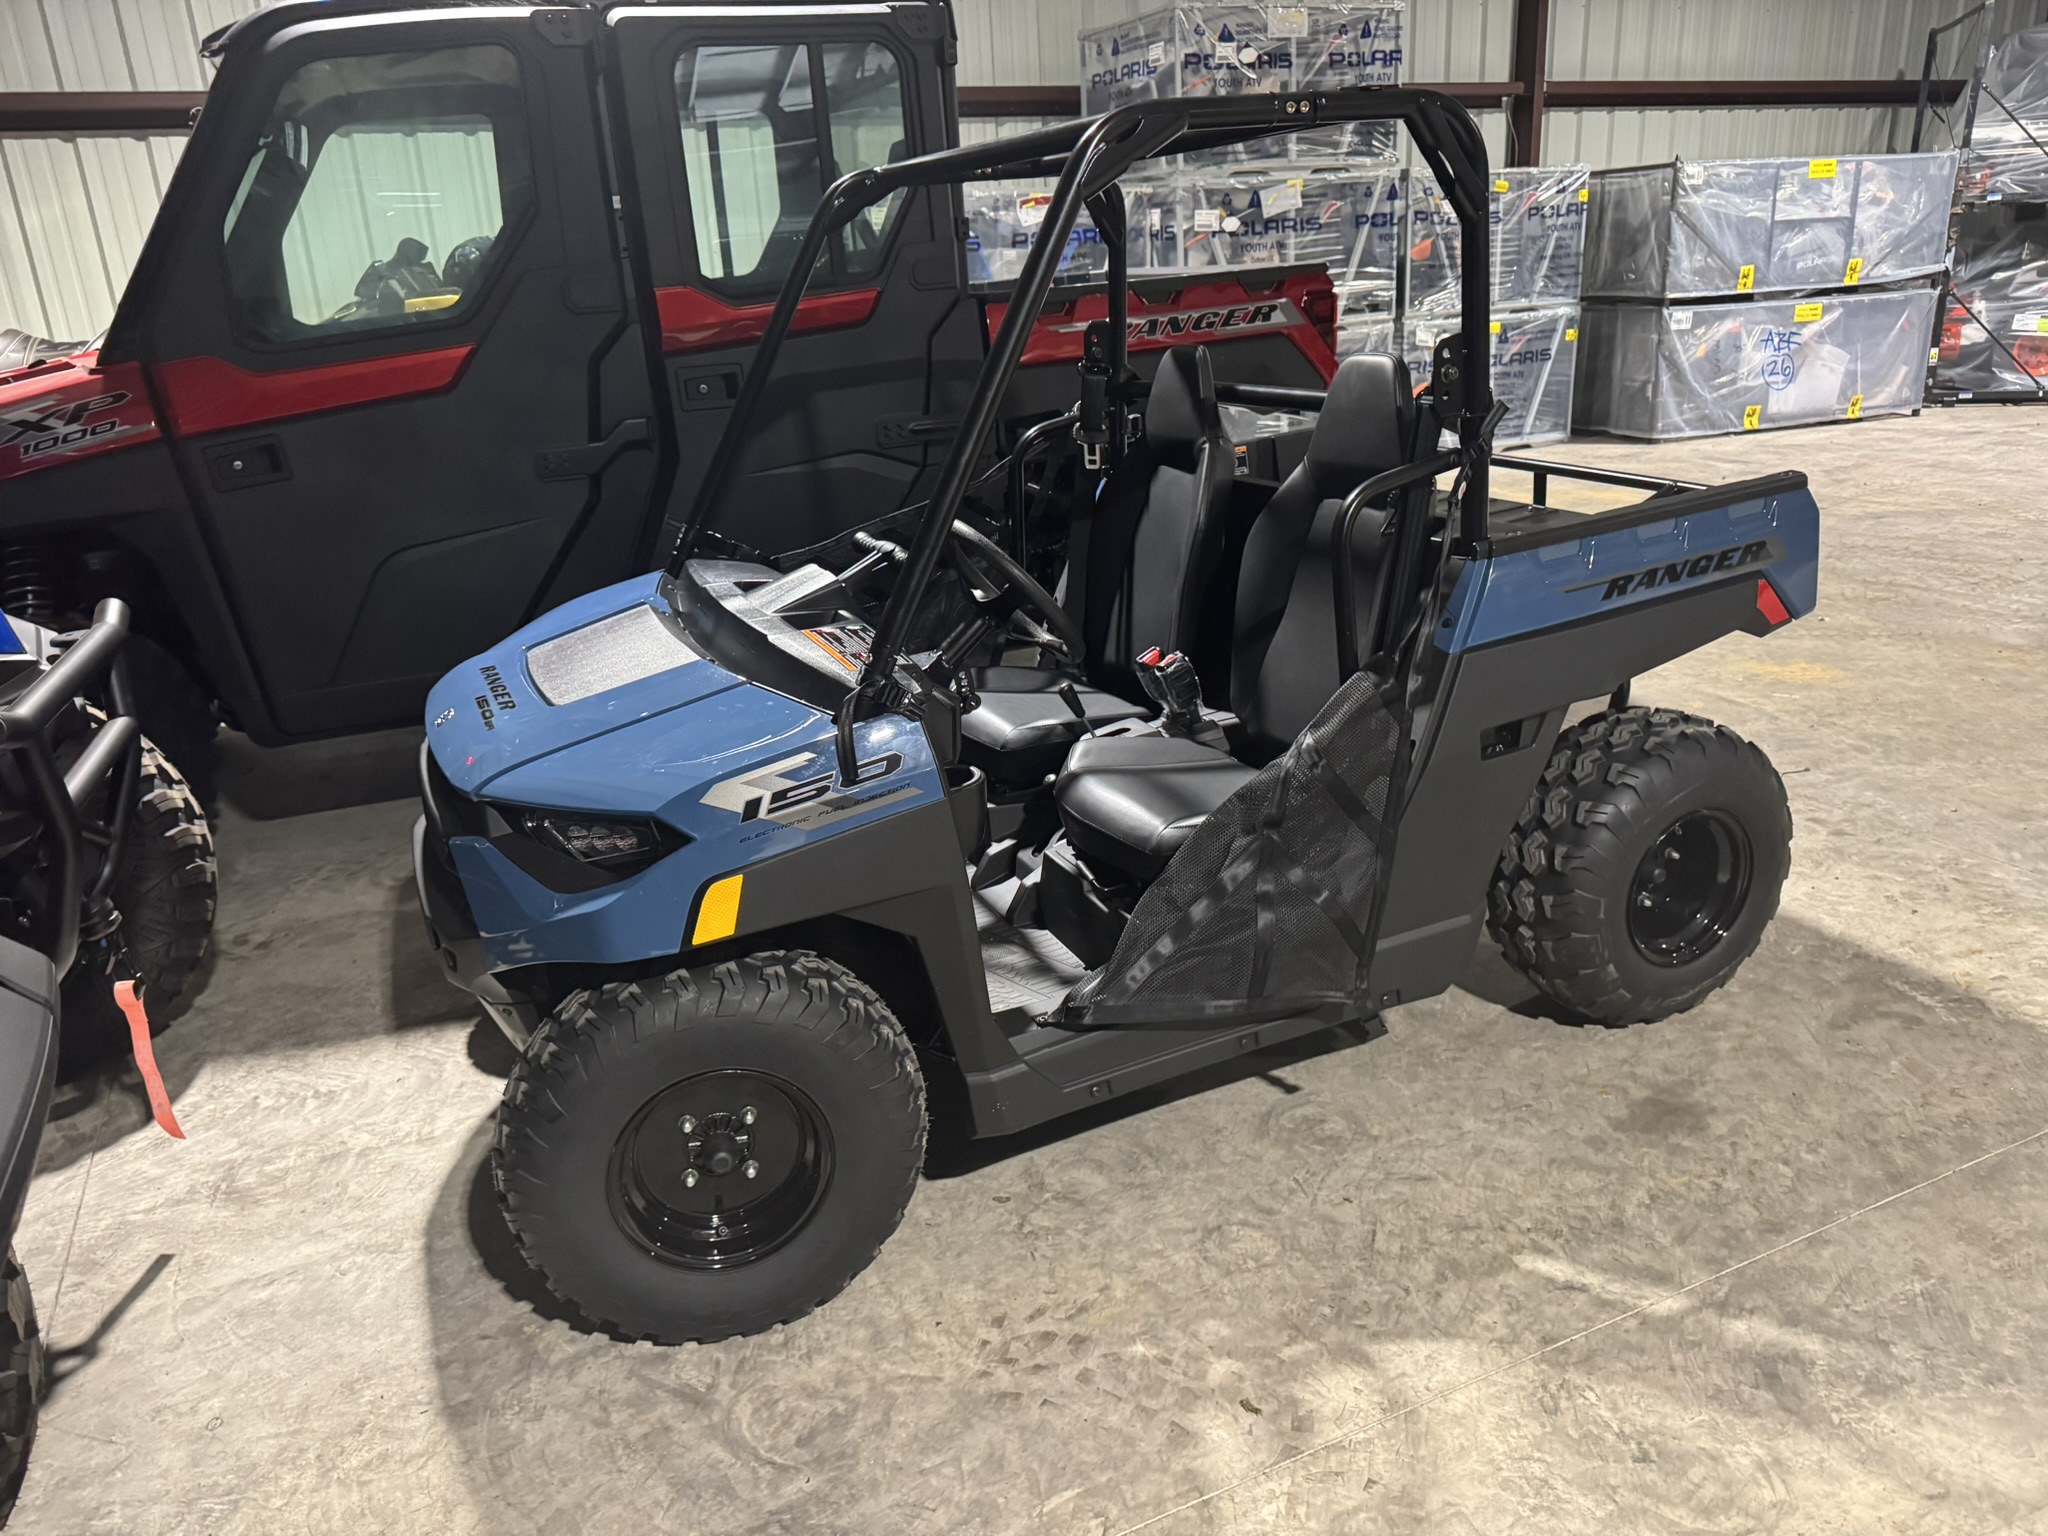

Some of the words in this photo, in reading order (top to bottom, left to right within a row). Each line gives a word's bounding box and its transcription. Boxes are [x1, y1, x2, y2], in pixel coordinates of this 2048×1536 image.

[1092, 58, 1157, 91] POLARIS
[1184, 52, 1292, 70] PORIS
[1377, 73, 1392, 82] ATV
[1240, 243, 1267, 253] YOUTH
[1128, 303, 1279, 341] ANGER
[1767, 359, 1791, 377] 26
[0, 390, 132, 448] XP
[20, 419, 119, 458] 1000
[1600, 540, 1768, 601] RANGER
[479, 665, 517, 711] RANGER
[739, 750, 904, 824] 150
[739, 815, 811, 844] ELECTRONIC
[817, 803, 848, 818] FUEL
